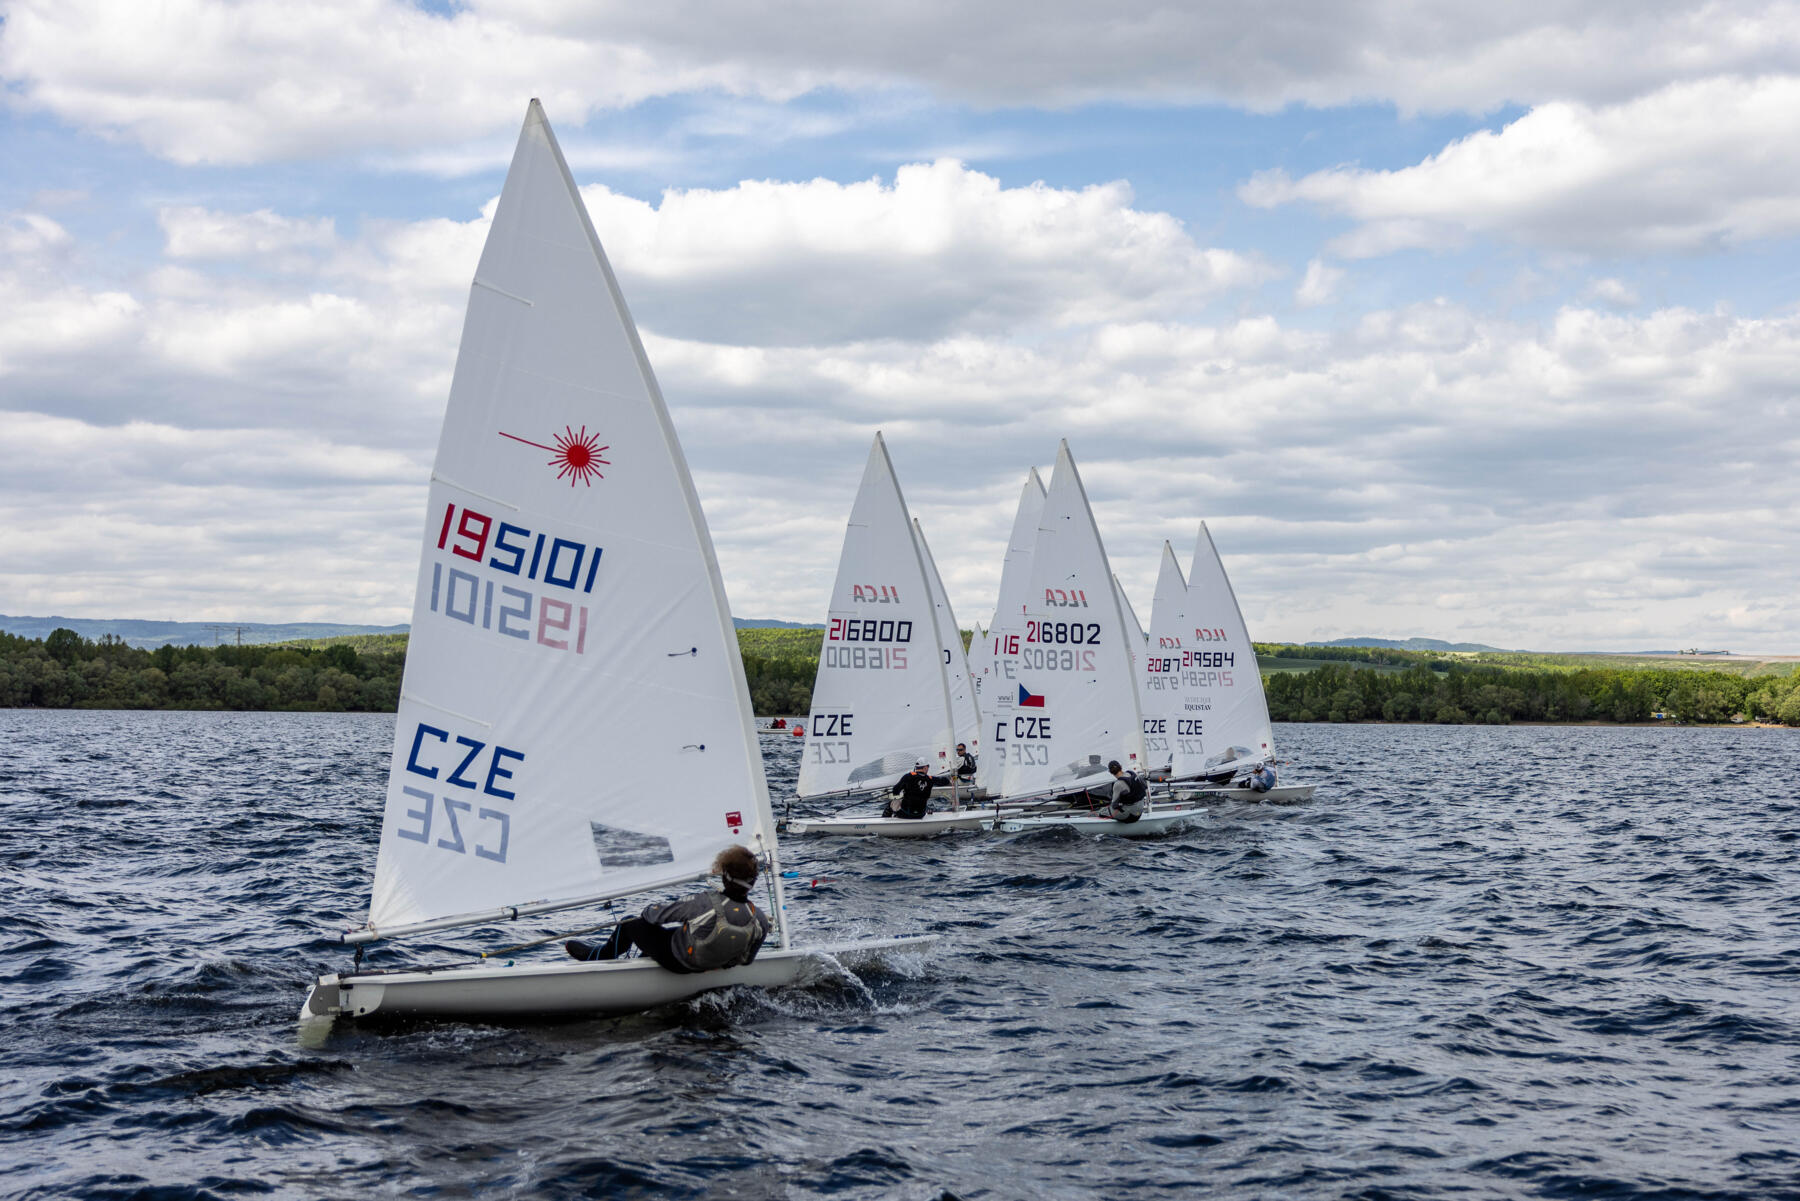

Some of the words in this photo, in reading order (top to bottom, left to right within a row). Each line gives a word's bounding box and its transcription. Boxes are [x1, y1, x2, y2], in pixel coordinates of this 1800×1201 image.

[437, 503, 603, 593] 195101
[829, 618, 913, 643] 216800
[1026, 620, 1101, 645] 216802
[1182, 650, 1235, 668] 219584
[812, 714, 854, 737] CZE
[1014, 716, 1052, 739] CZE
[1143, 719, 1167, 734] CZE
[1177, 719, 1203, 735] CZE
[406, 722, 525, 800] CZE
